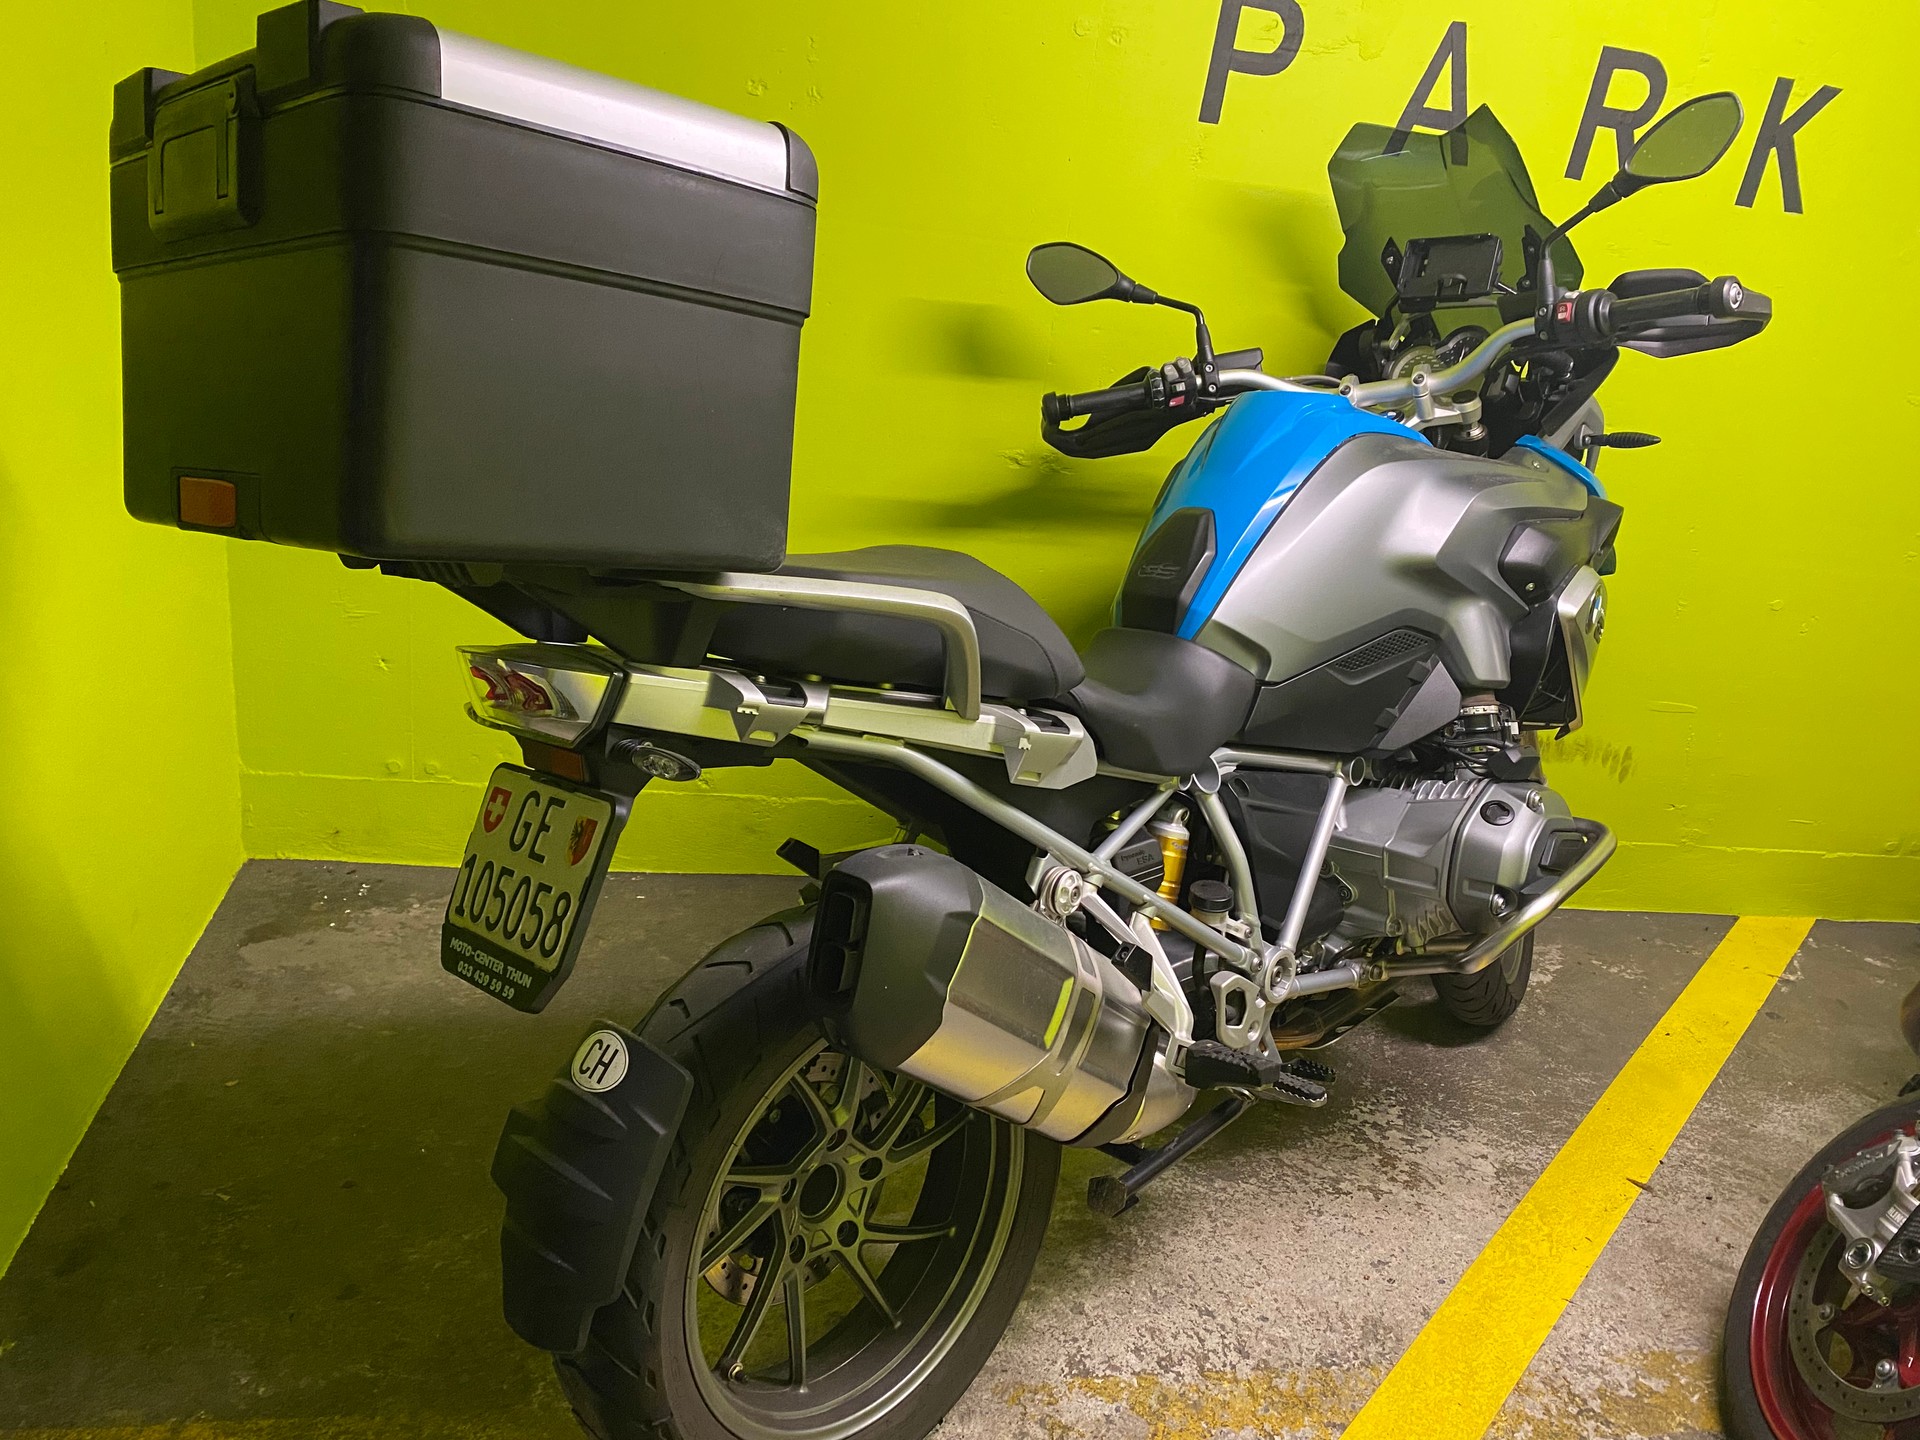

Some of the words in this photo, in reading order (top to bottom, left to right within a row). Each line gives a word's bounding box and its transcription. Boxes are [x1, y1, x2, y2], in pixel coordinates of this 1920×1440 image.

[1198, 0, 1843, 215] PARK
[509, 790, 566, 864] GE
[455, 853, 571, 958] 105058
[449, 937, 504, 975] MOTO-CENTER
[506, 966, 532, 988] THUN
[457, 961, 473, 978] 033
[473, 969, 489, 986] 439
[489, 979, 502, 993] 59
[502, 985, 515, 1000] 59
[579, 1038, 619, 1084] CH
